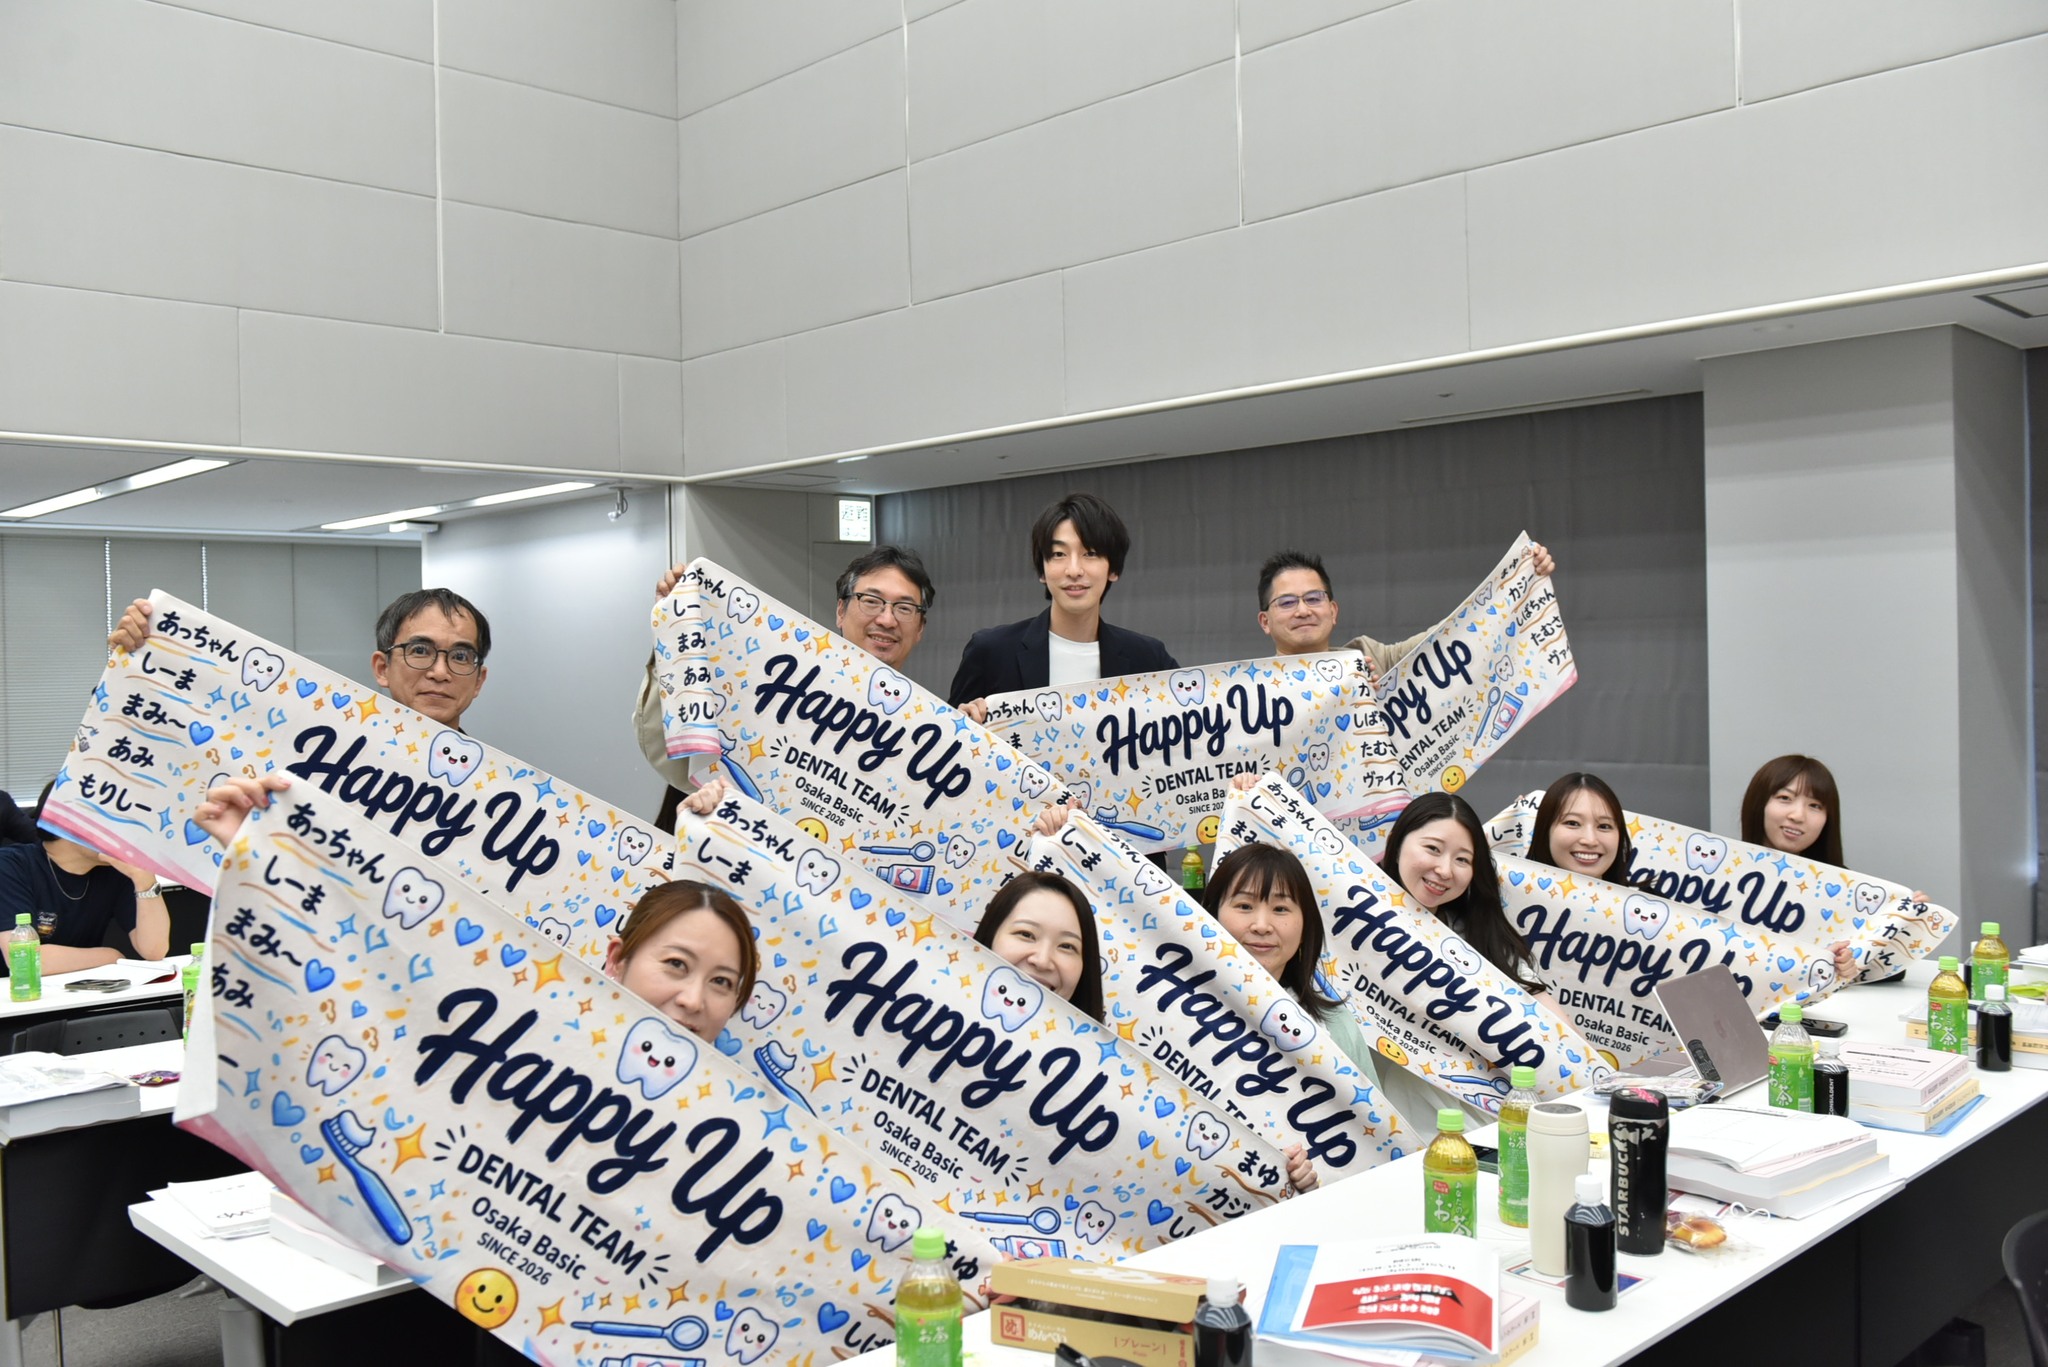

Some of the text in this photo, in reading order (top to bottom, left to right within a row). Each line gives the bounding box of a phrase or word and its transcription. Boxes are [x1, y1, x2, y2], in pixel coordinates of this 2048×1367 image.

[1509, 574, 1534, 602] カジー
[1516, 588, 1555, 626] しばちゃん
[156, 611, 240, 663] あっちゃん
[142, 651, 197, 692] しーま
[1412, 639, 1473, 689] Up
[107, 736, 155, 768] あみ
[754, 654, 972, 809] Happy Up
[1096, 684, 1294, 777] Happy Up
[1399, 706, 1466, 771] ENTAL TEAM
[1155, 766, 1214, 794] DENTAL
[1215, 760, 1257, 780] TEAM
[1363, 770, 1407, 788] ヴァイス
[1414, 734, 1460, 777] Osaka Basic
[1428, 749, 1457, 778] SINCE 2026
[78, 773, 152, 812] もりしー
[784, 746, 897, 819] DENTAL TEAM
[795, 776, 864, 823] Osaka Basic
[1175, 791, 1209, 806] Osaka
[287, 725, 561, 893] Happy Up
[800, 797, 846, 827] SINCE 2026
[1189, 801, 1224, 815] SINCE 202
[1251, 795, 1288, 829] しーま
[1267, 782, 1315, 831] あっちゃん
[287, 803, 385, 884] あっちゃん
[717, 800, 795, 862] あっちゃん
[1061, 828, 1101, 871] しーま
[1230, 820, 1260, 844] まみ
[1492, 822, 1523, 841] しーま
[264, 855, 326, 915] しーま
[697, 837, 752, 886] しーま
[1737, 871, 1806, 933] Up
[1897, 896, 1928, 916] まゆ
[1516, 904, 1673, 997] Happy
[212, 963, 254, 1009] あみ
[1331, 885, 1546, 1068] Happy Up
[1354, 974, 1468, 1052] DENTAL TEAM
[1559, 988, 1626, 1019] DENTAL
[824, 941, 1119, 1165] Happy Up
[1366, 1005, 1437, 1055] Osaka Basic
[1376, 1022, 1419, 1056] SINCE 2026
[1574, 1013, 1650, 1046] Osaka Basic
[1585, 1032, 1632, 1053] SINCE 2026
[1136, 941, 1357, 1168] Happy Up
[414, 987, 785, 1263] Happy Up
[860, 1068, 1011, 1175] DENTAL TEAM
[874, 1110, 964, 1180] Osaka Basic
[880, 1140, 939, 1184] SINCE 2026
[1237, 1150, 1280, 1188] まゆ
[457, 1144, 647, 1276] DENTAL TEAM
[1205, 1187, 1251, 1219] カジ
[472, 1196, 587, 1281] Osaka Basic
[476, 1232, 553, 1286] SINCE 2026
